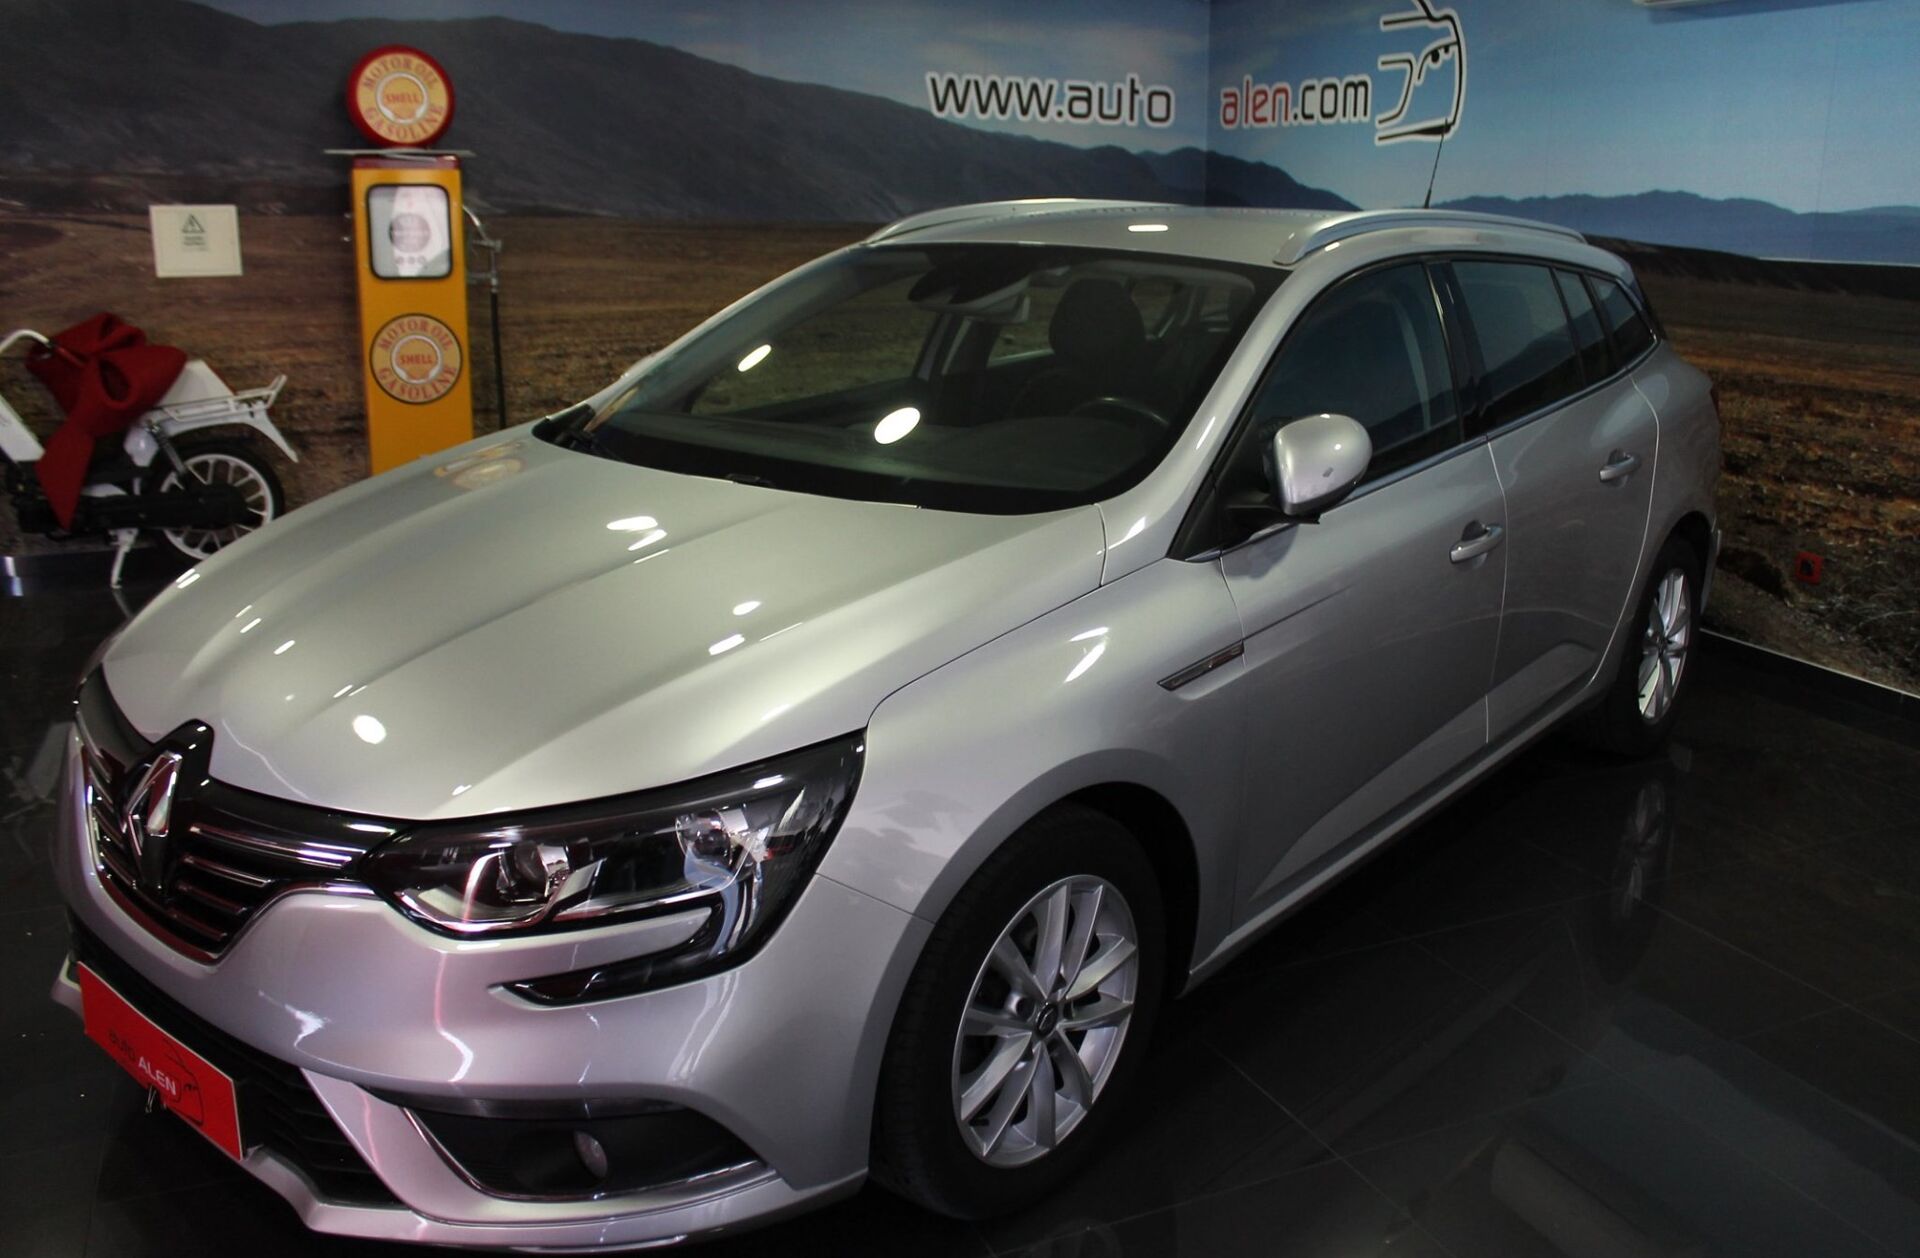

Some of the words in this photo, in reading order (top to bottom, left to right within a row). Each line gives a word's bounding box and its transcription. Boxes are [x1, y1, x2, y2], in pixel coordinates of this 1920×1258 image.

[362, 56, 412, 90] MOTOR
[415, 64, 439, 89] OIL
[386, 94, 419, 103] SHELL
[928, 76, 1172, 124] www.auto
[1222, 78, 1370, 127] alen.com
[364, 107, 443, 140] GASOLINE
[378, 320, 429, 350] MOTOR
[431, 326, 453, 351] OIL
[401, 354, 433, 365] SHELL
[378, 367, 457, 400] GASOLINE
[138, 1056, 177, 1096] ALEN
